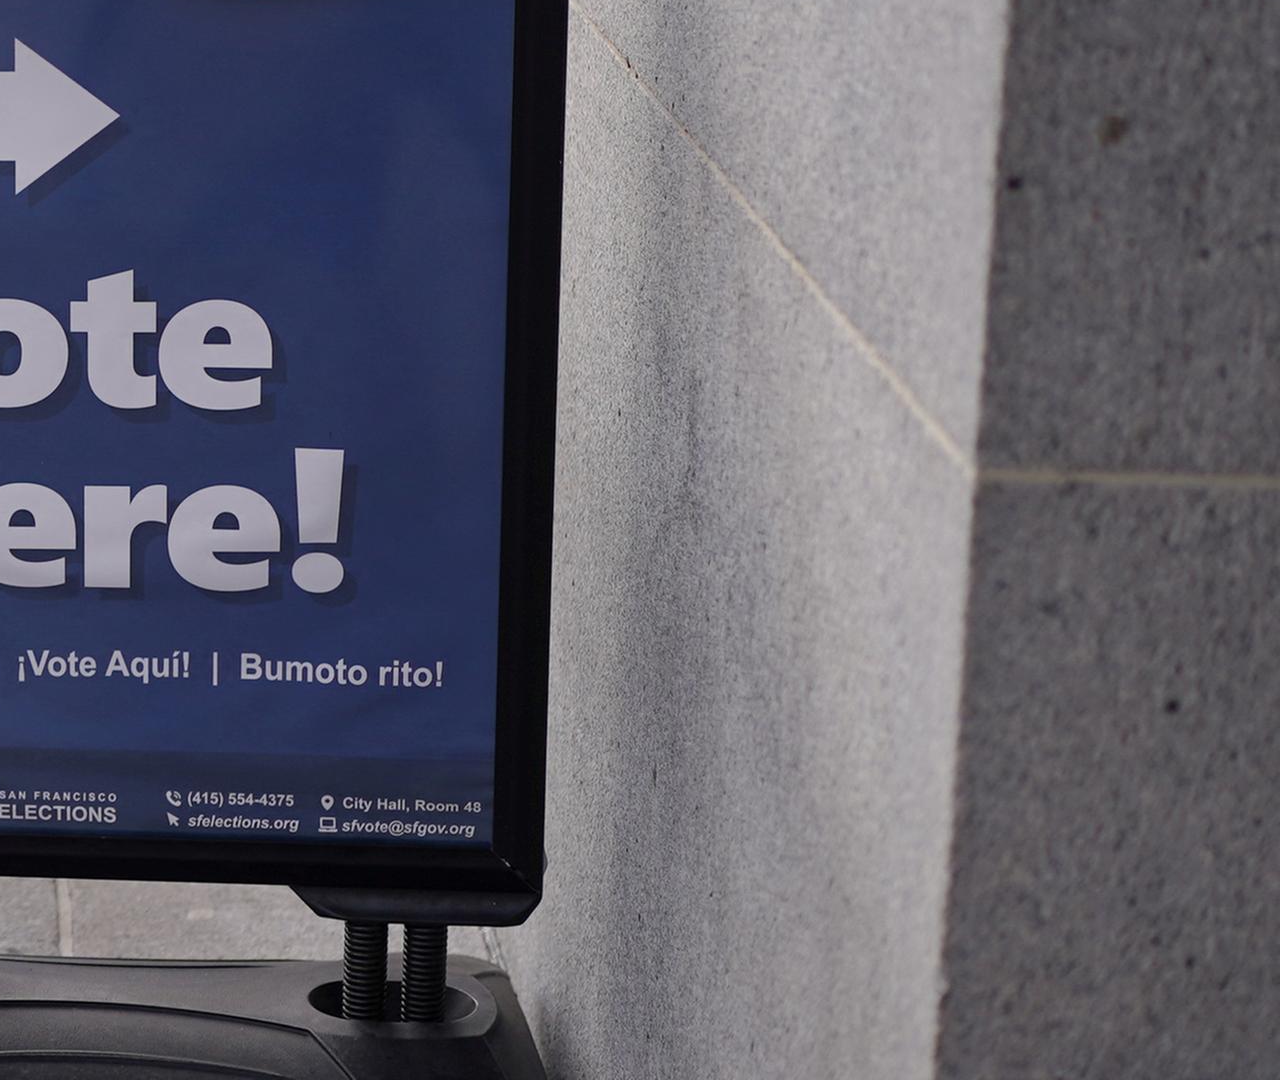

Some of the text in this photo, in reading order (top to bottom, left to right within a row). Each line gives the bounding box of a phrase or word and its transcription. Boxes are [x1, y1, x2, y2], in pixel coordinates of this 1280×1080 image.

[18, 649, 97, 682] ¡Vote
[105, 649, 190, 684] Aquí!
[240, 652, 368, 686] Bumoto
[379, 659, 443, 688] rito!
[33, 791, 117, 803] FRANCISCO
[187, 791, 294, 808] (415) 554-4375
[342, 796, 482, 813] City Hall, Room 48
[187, 814, 300, 833] sfelections.org
[341, 819, 476, 838] sfvote@sfgov.org
